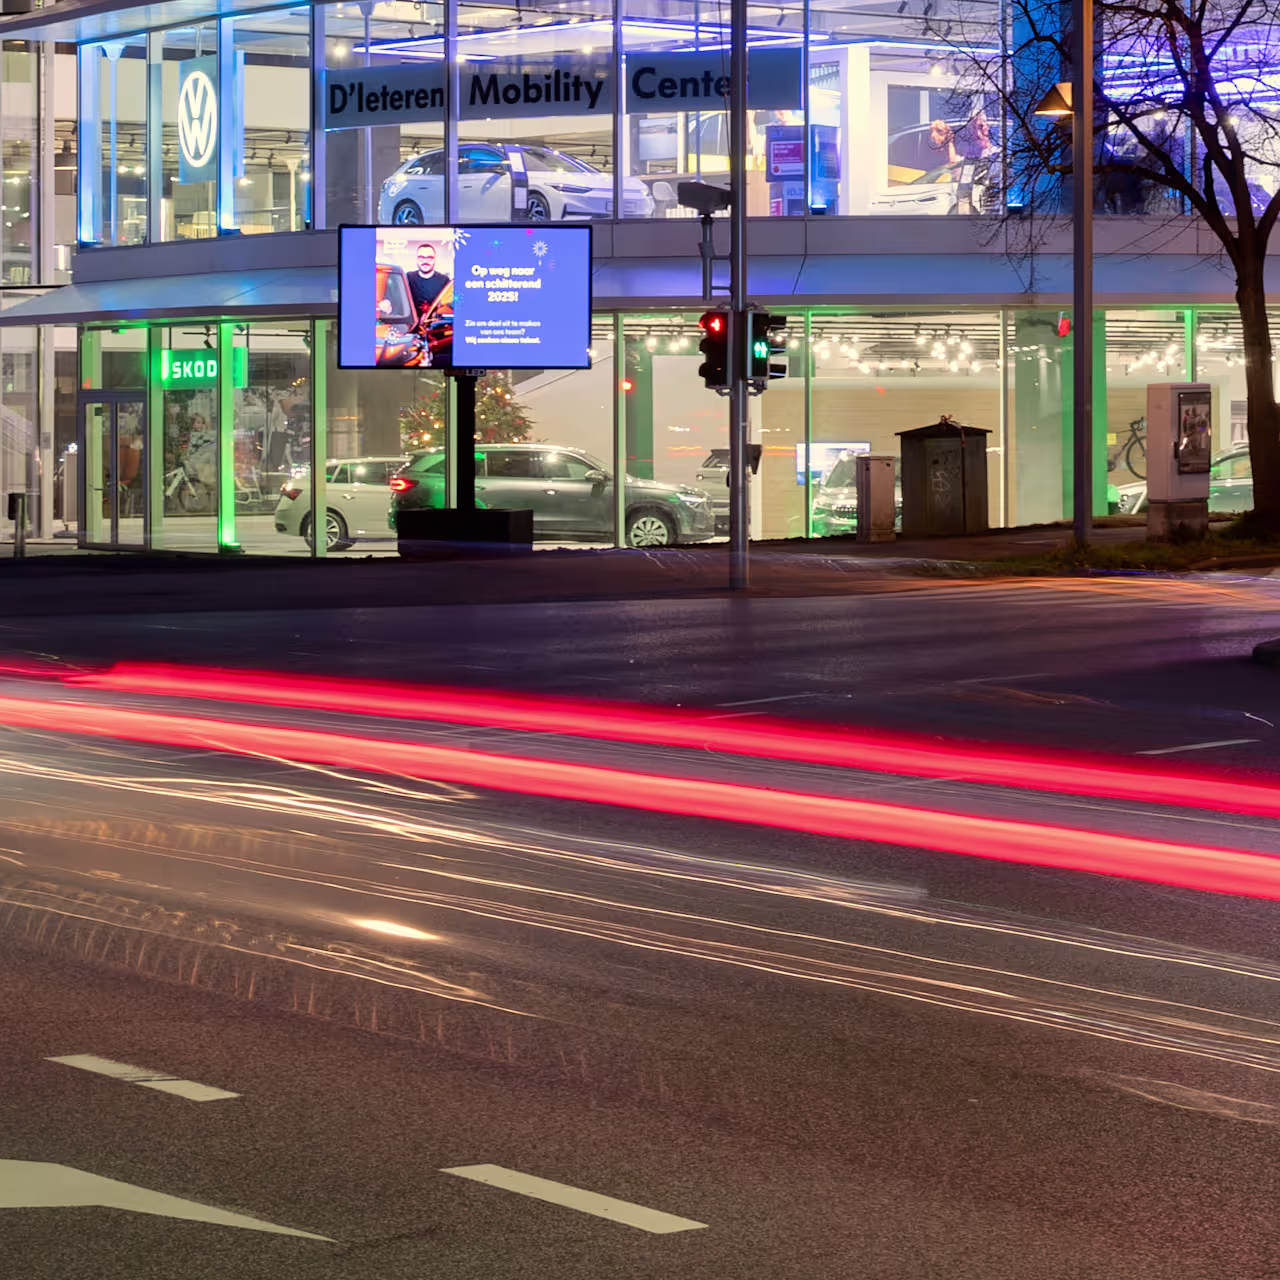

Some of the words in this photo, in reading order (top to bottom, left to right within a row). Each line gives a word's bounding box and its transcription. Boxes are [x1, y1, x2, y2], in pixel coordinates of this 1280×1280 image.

[329, 83, 445, 115] D'Ieteren
[469, 70, 605, 110] Mobility
[631, 66, 749, 99] Cente
[471, 264, 488, 278] Op
[488, 267, 510, 278] weg
[511, 267, 536, 276] naar
[464, 280, 484, 289] een
[485, 278, 541, 289] schitterend
[487, 290, 519, 302] 2025!
[172, 359, 218, 379] SKOD
